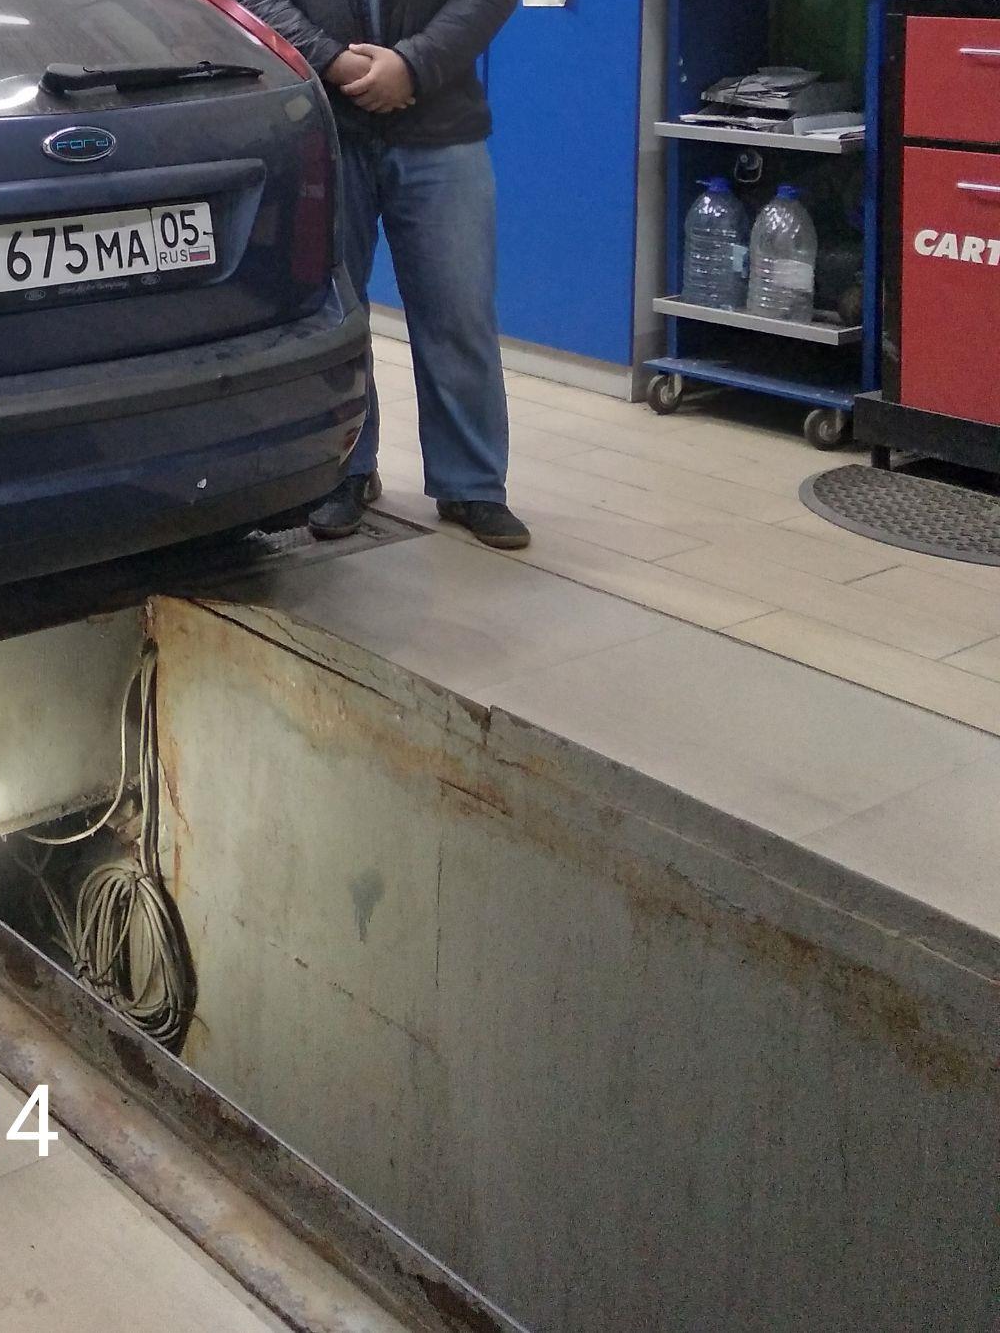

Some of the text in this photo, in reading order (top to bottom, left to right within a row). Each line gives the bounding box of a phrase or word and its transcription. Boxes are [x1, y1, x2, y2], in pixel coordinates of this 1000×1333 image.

[160, 210, 199, 249] 05
[914, 229, 1000, 266] CART
[159, 249, 188, 265] RUS
